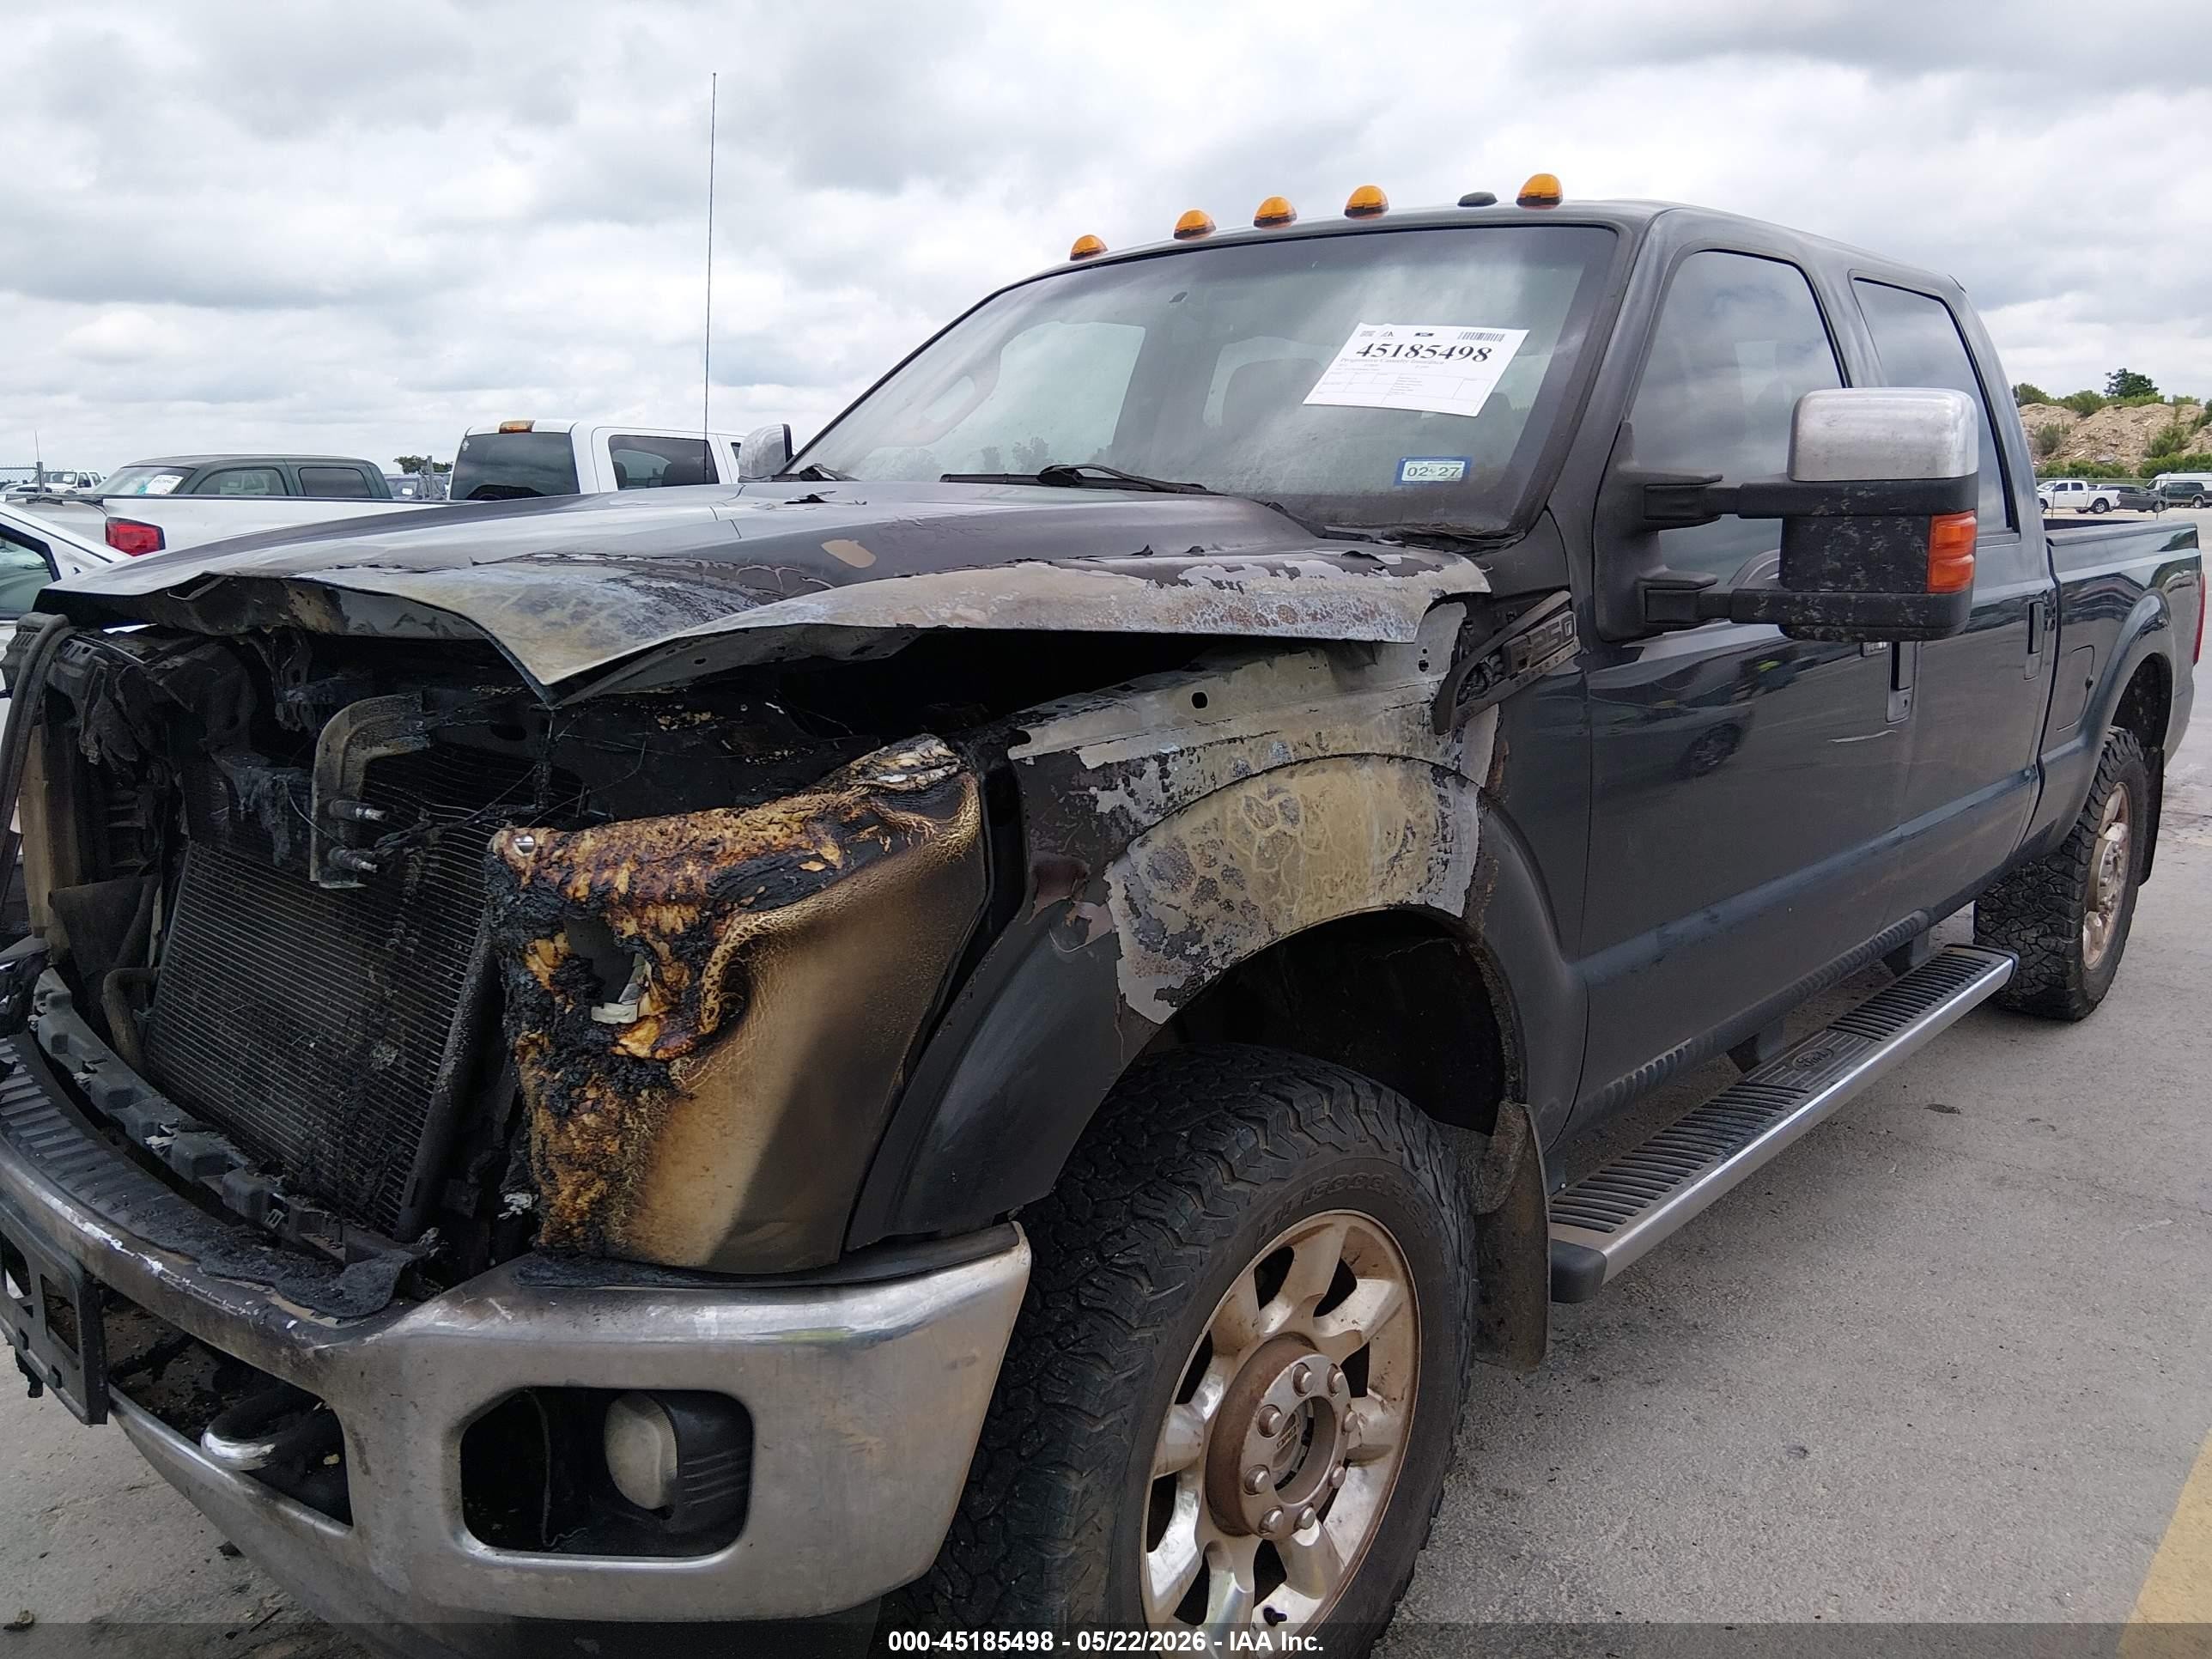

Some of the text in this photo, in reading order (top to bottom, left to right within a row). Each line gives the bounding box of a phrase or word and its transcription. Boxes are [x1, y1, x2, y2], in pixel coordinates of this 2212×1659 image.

[1356, 343, 1492, 362] 45185498
[1407, 466, 1460, 477] 02 27
